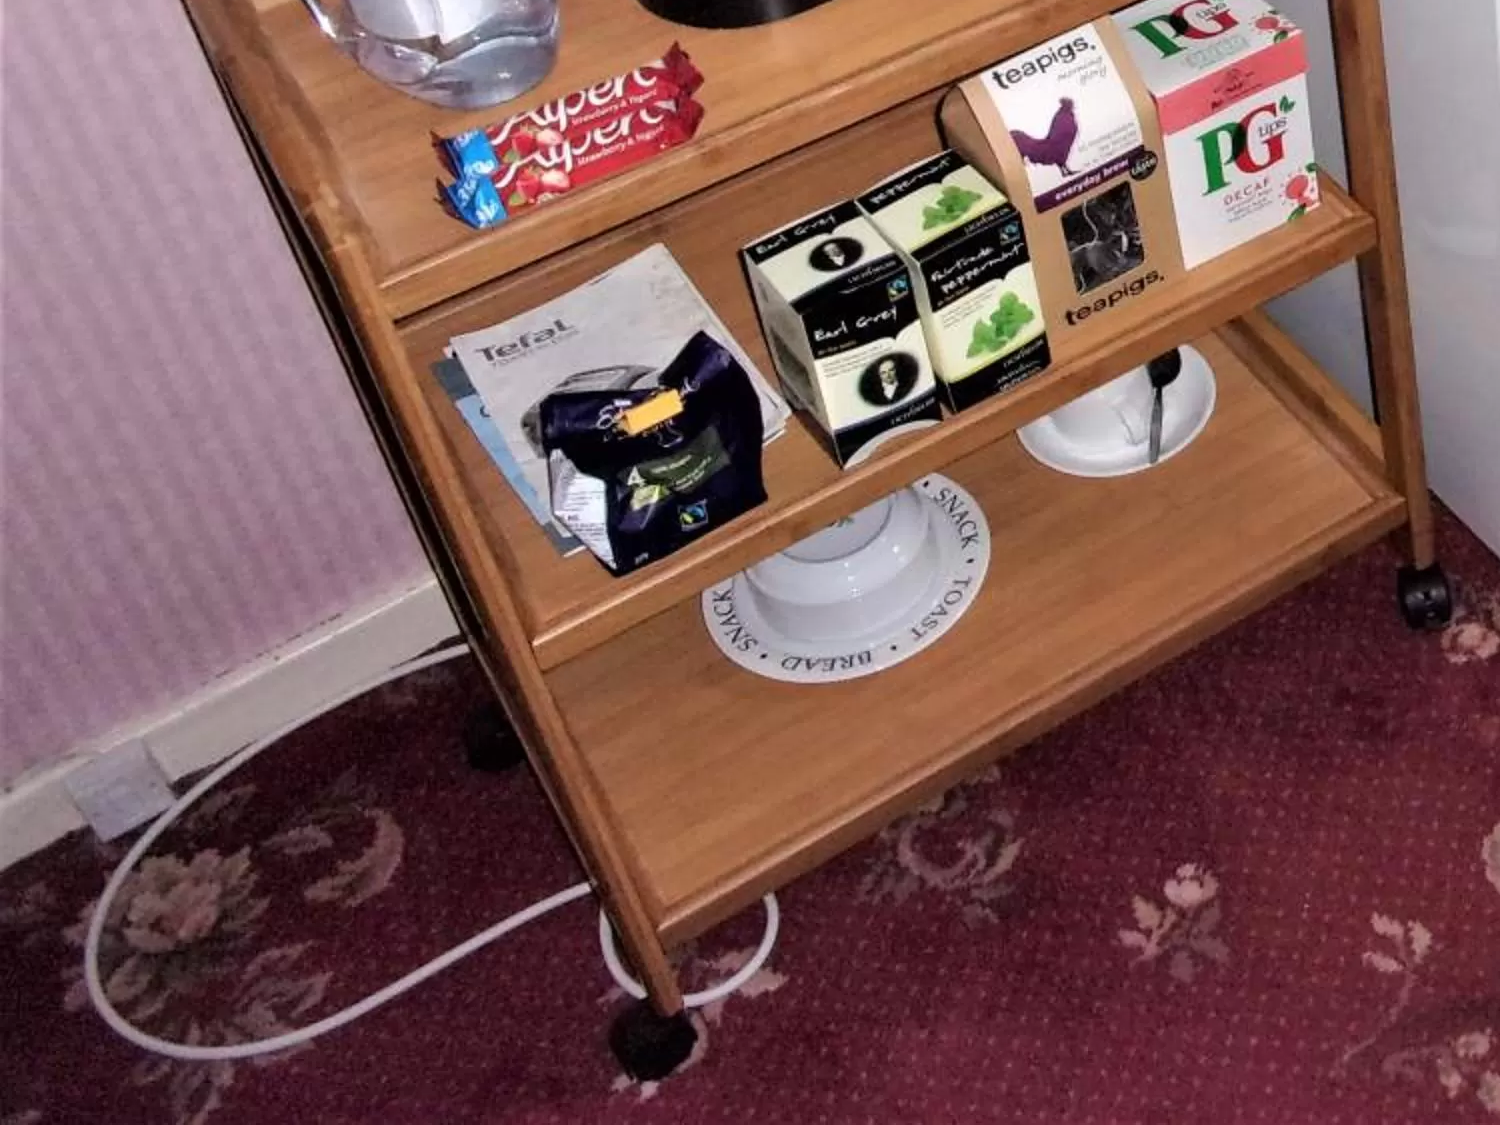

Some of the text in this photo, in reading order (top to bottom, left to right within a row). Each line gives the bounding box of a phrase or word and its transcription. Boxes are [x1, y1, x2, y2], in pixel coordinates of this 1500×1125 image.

[992, 36, 1097, 89] teapigs.
[1258, 116, 1288, 138] tips
[576, 142, 626, 166] Strawberry
[1195, 102, 1289, 197] PG
[1055, 158, 1130, 201] everyday brew
[1223, 178, 1271, 206] DECAF
[755, 214, 837, 255] Earl Grey
[1065, 269, 1165, 325] teapigs.
[813, 305, 898, 342] Earl Grey
[711, 486, 979, 672] SNACK TOAST BREAD SNACK
